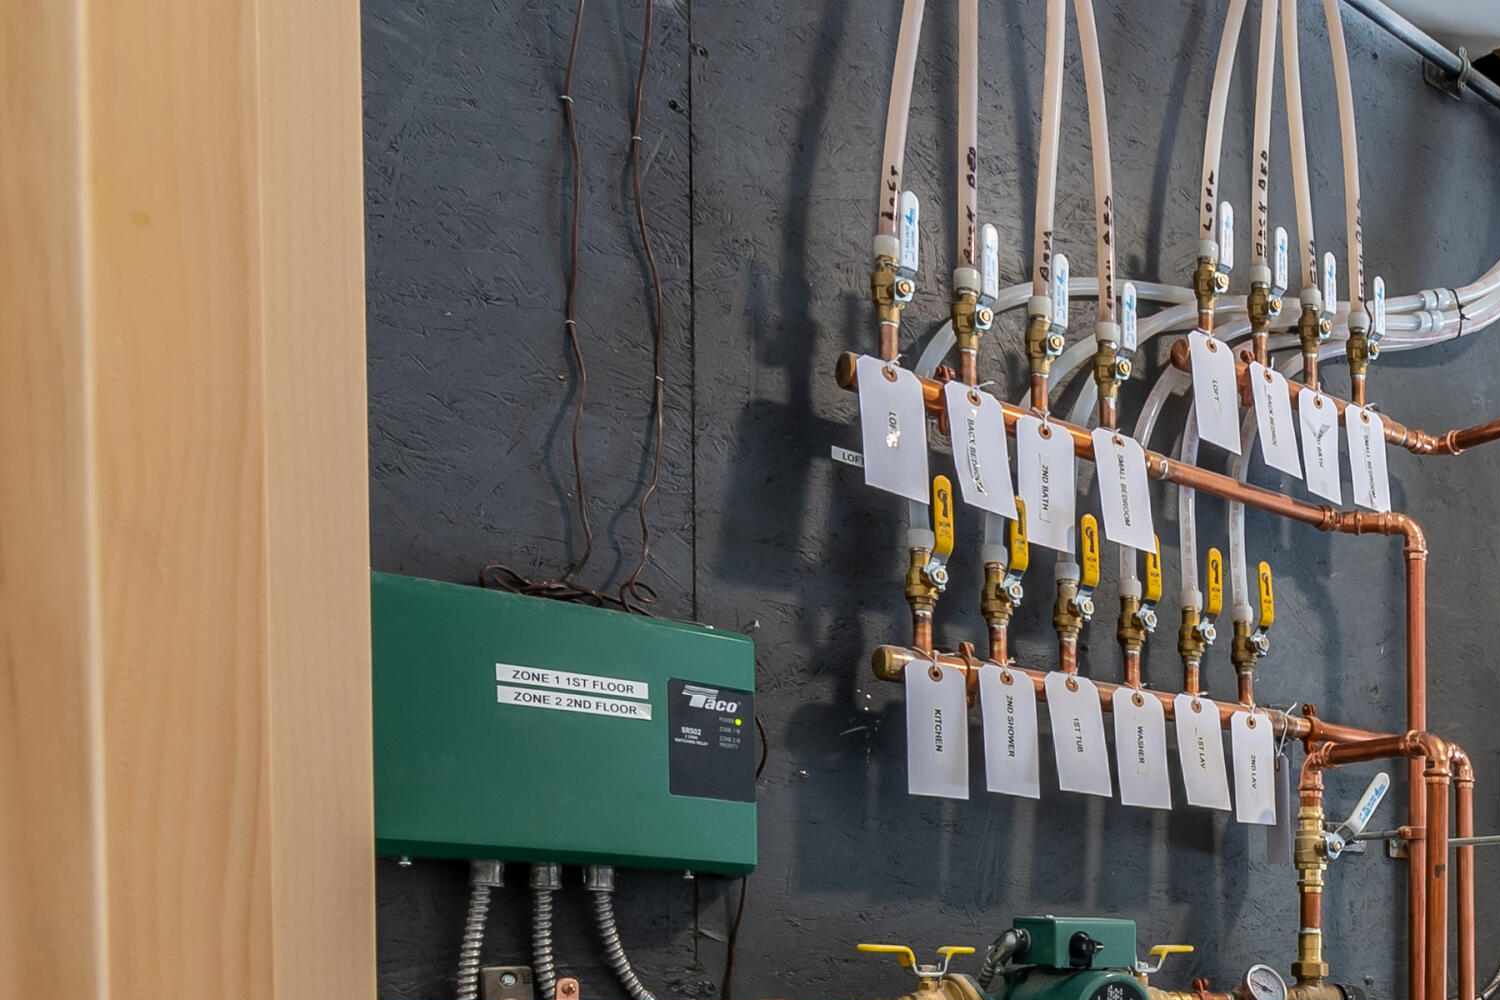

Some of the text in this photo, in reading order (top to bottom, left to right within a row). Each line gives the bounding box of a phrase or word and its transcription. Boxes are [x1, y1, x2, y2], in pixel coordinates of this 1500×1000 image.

[888, 411, 897, 437] LOF
[1117, 454, 1131, 527] SMALL BEDROOM
[512, 669, 635, 695] ZONE 1 1ST FLOOR
[682, 684, 738, 713] Taco
[513, 692, 637, 715] ZONE 2 2ND FLOOR
[934, 709, 943, 752] KITCHEN
[1006, 695, 1015, 758] 2ND SHOWER
[1073, 718, 1084, 753] 1ST TUB
[1137, 726, 1145, 764] WASHER
